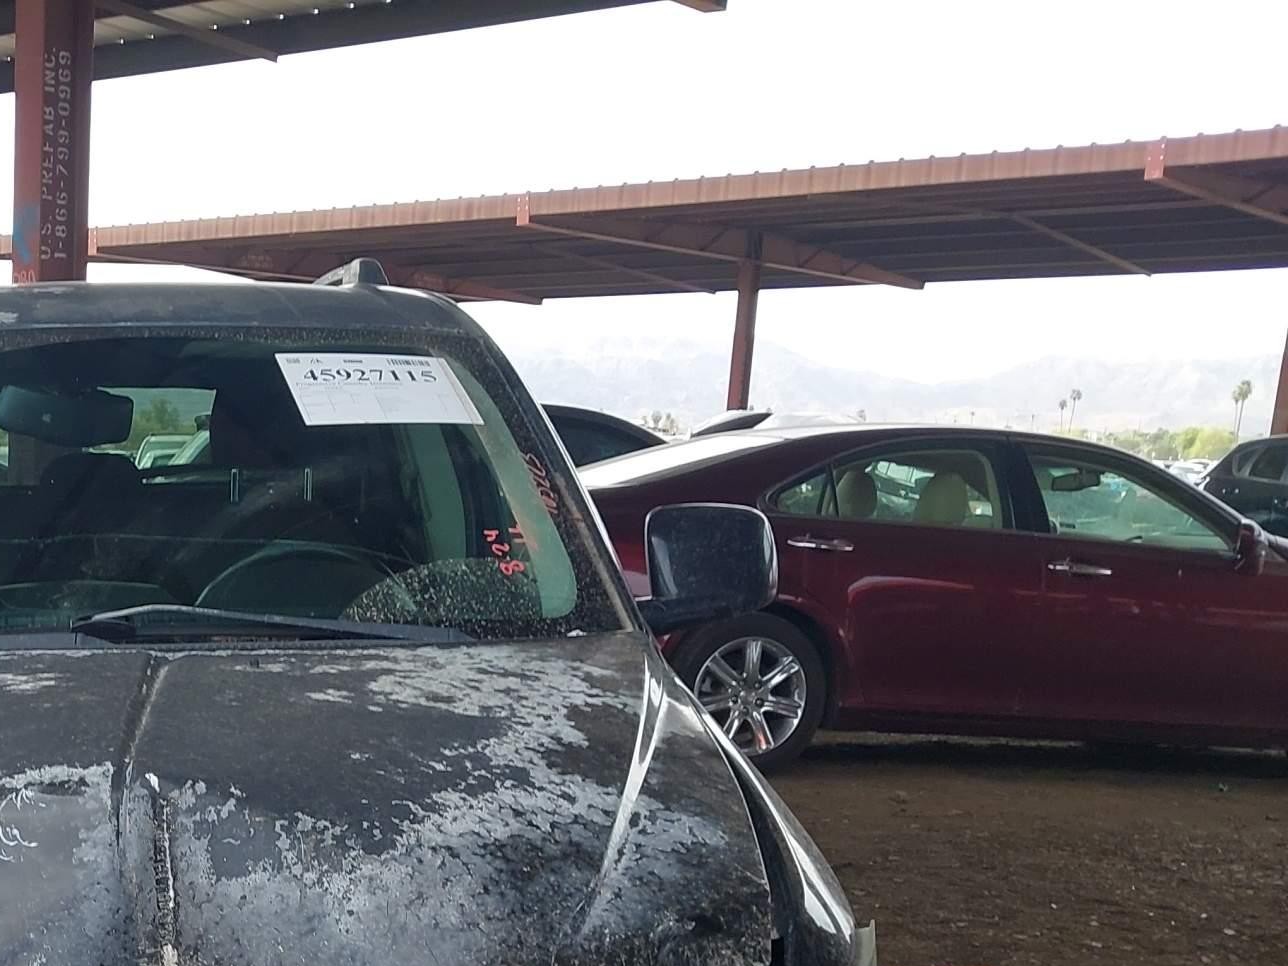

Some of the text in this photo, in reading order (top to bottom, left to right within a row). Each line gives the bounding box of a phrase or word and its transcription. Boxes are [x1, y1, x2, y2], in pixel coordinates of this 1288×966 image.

[41, 105, 56, 202] PREFAB
[54, 49, 73, 260] 1-866-799-0969
[303, 368, 437, 384] 45927115
